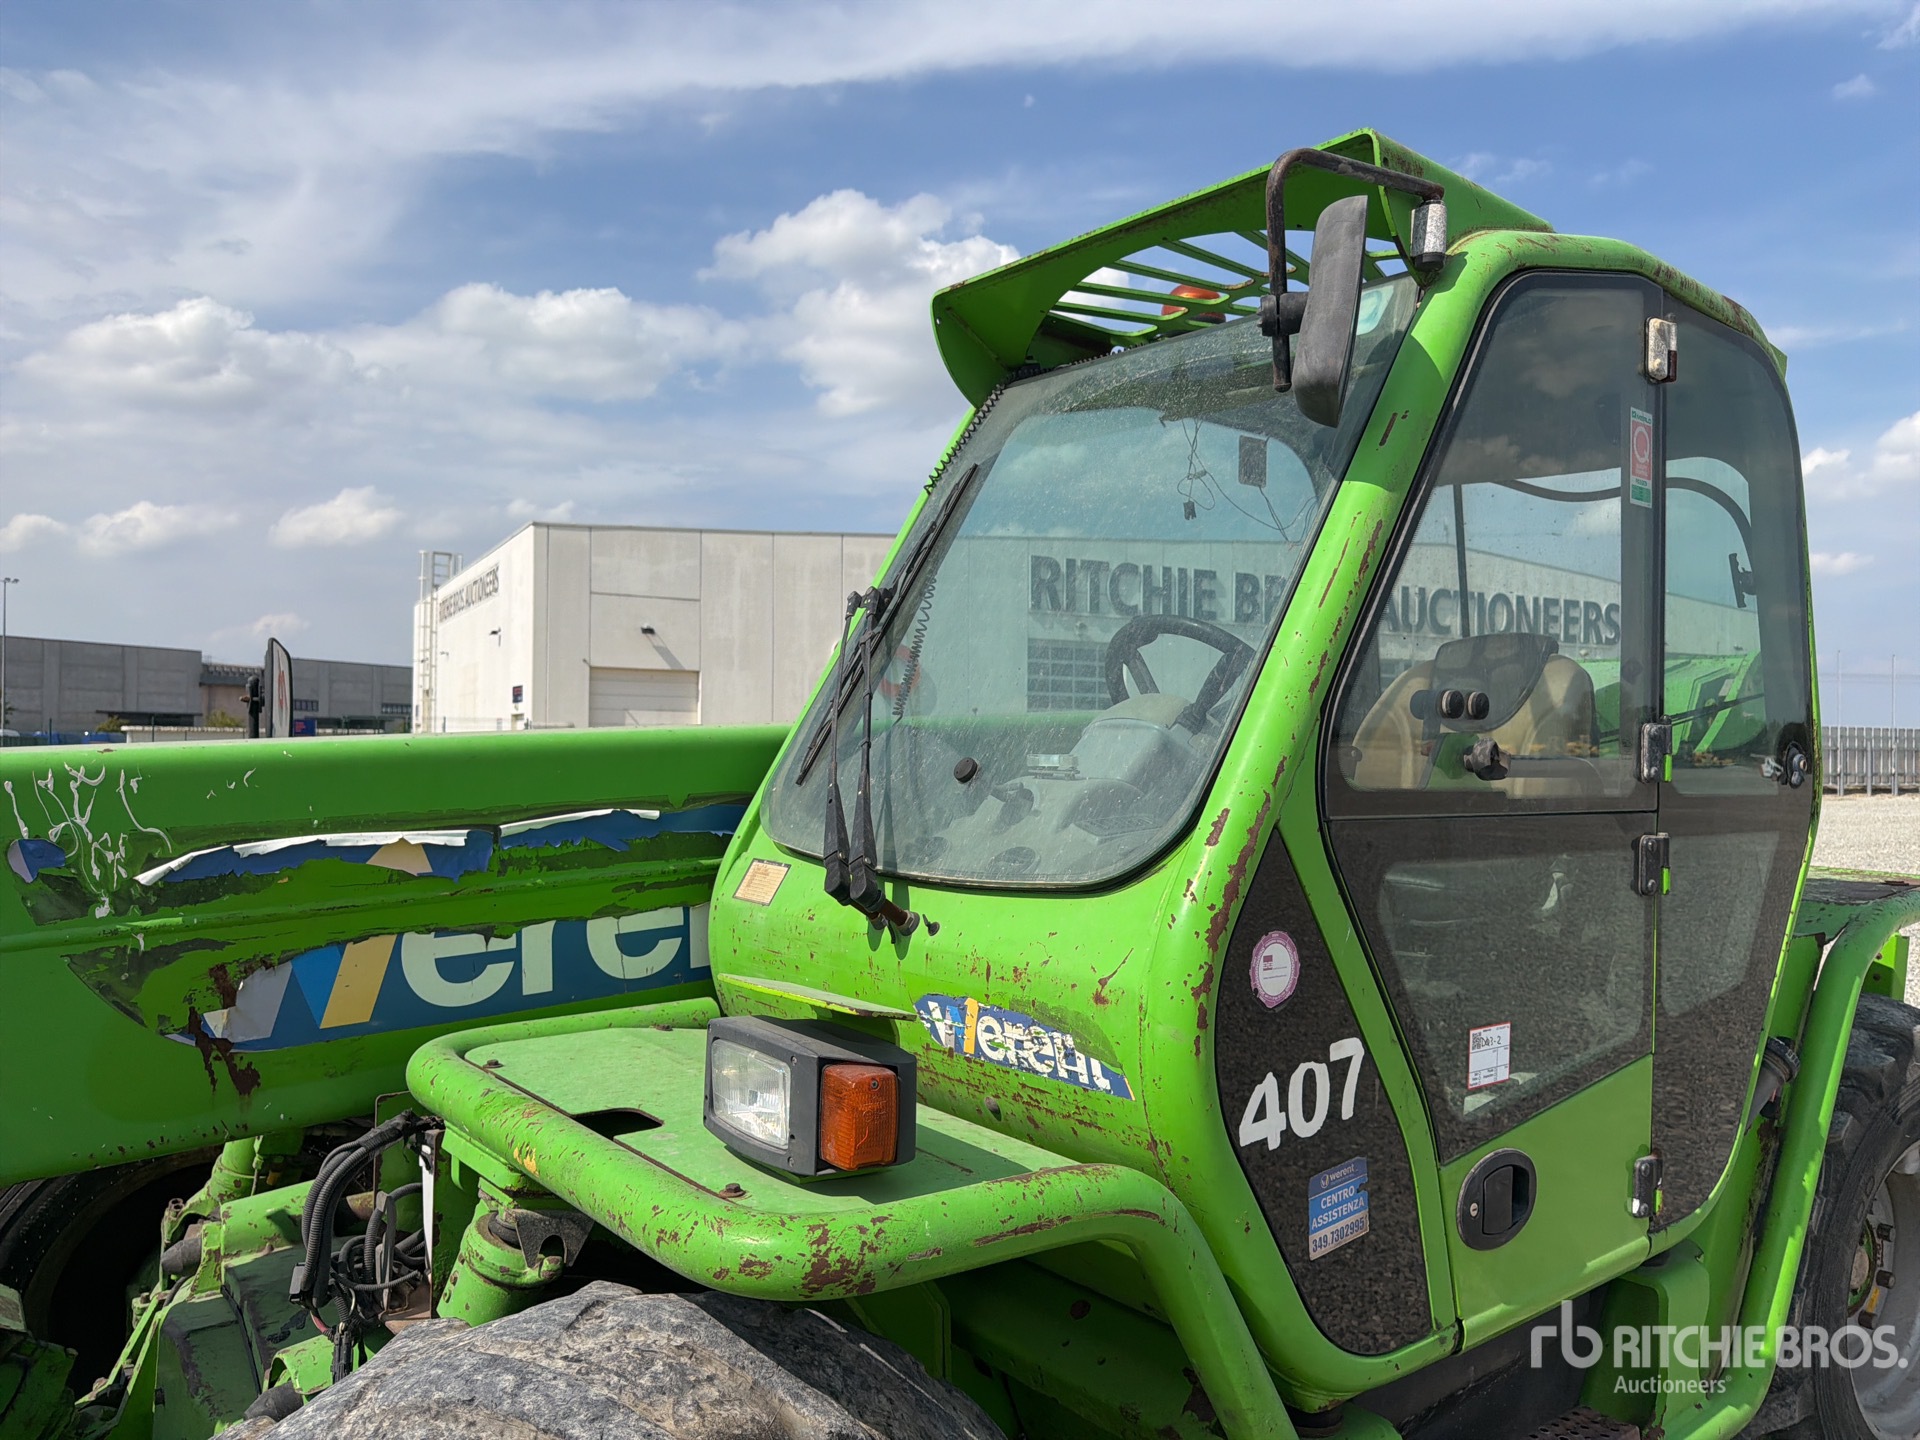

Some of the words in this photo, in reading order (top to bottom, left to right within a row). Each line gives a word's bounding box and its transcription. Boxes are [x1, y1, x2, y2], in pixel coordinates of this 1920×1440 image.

[1029, 554, 1218, 622] RITCHIE
[1238, 1036, 1365, 1151] 407
[1311, 1196, 1365, 1231] ASSISTENZA
[1320, 1185, 1355, 1210] CENTRO
